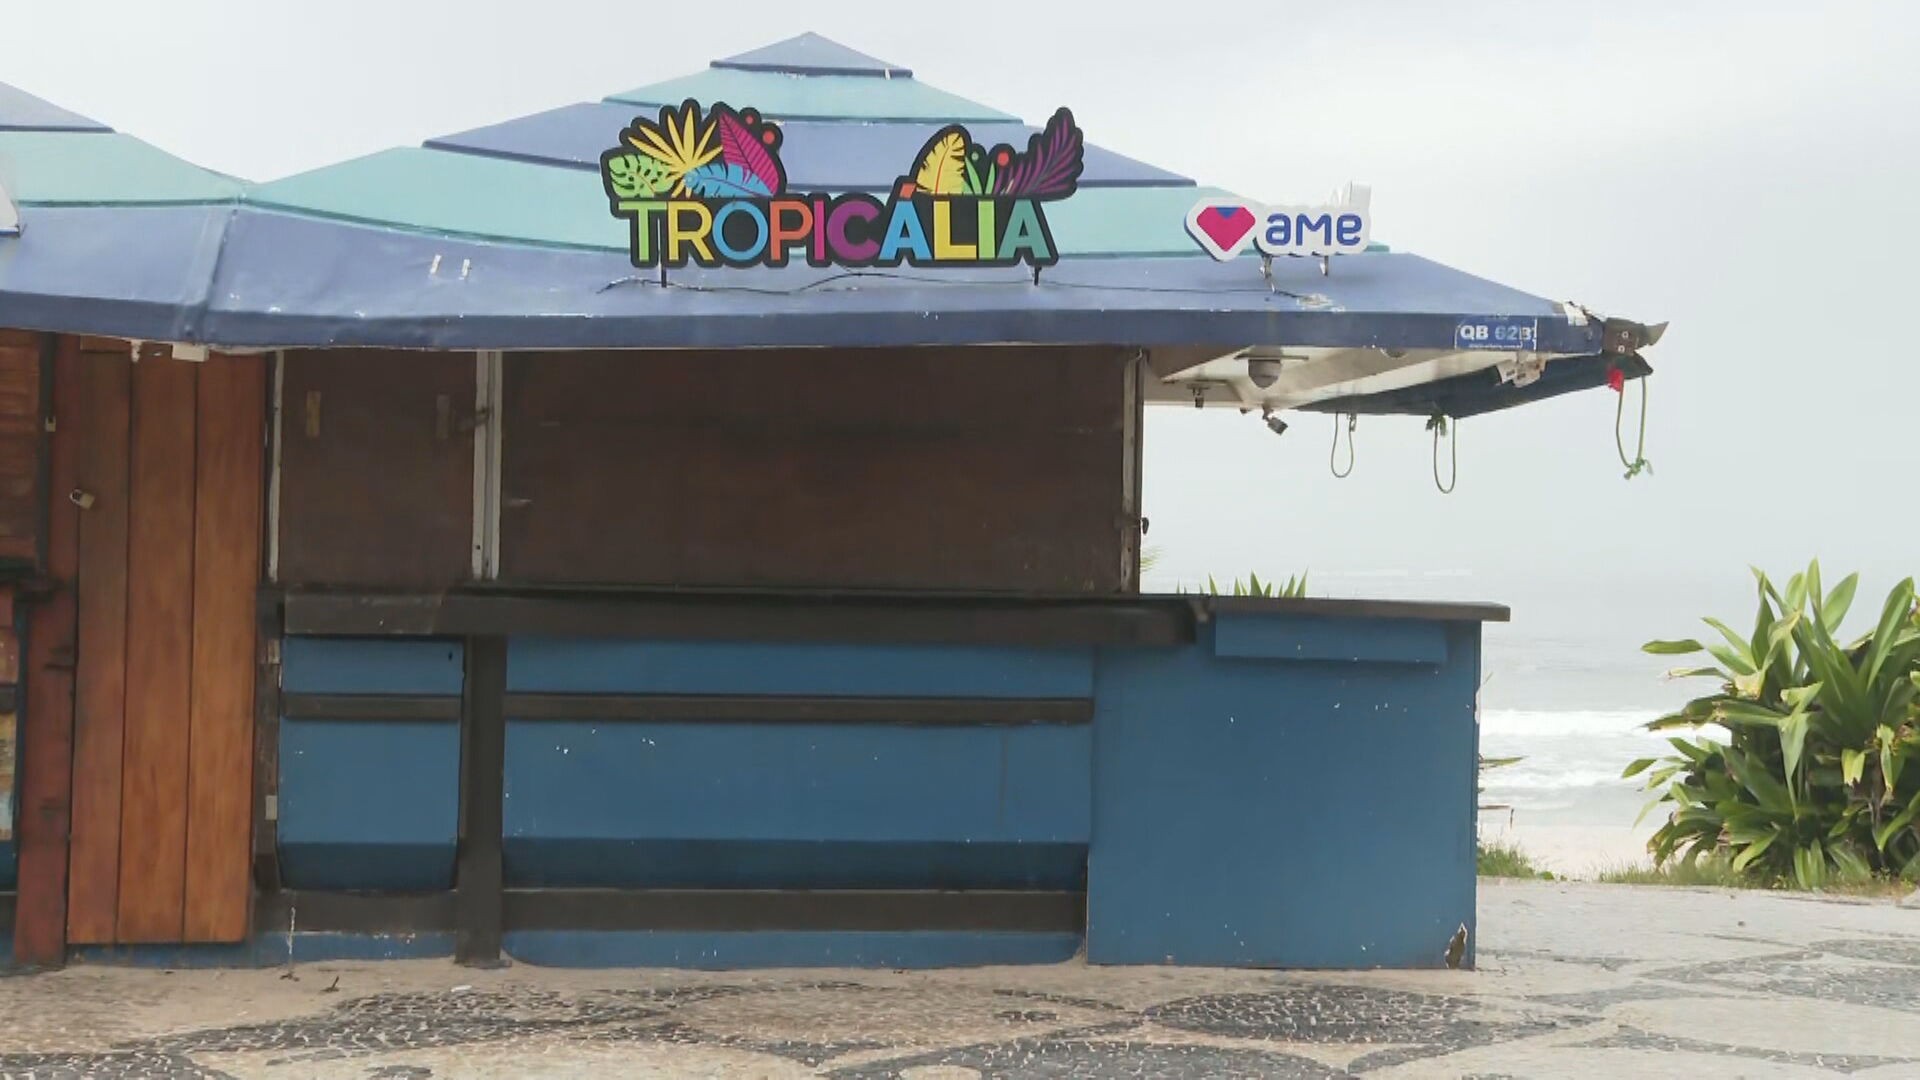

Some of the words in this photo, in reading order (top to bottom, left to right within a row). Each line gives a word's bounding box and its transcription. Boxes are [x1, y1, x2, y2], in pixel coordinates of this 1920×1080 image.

[618, 183, 1051, 261] TROPICÁLIA
[1265, 212, 1362, 246] ame
[1460, 324, 1489, 341] QB
